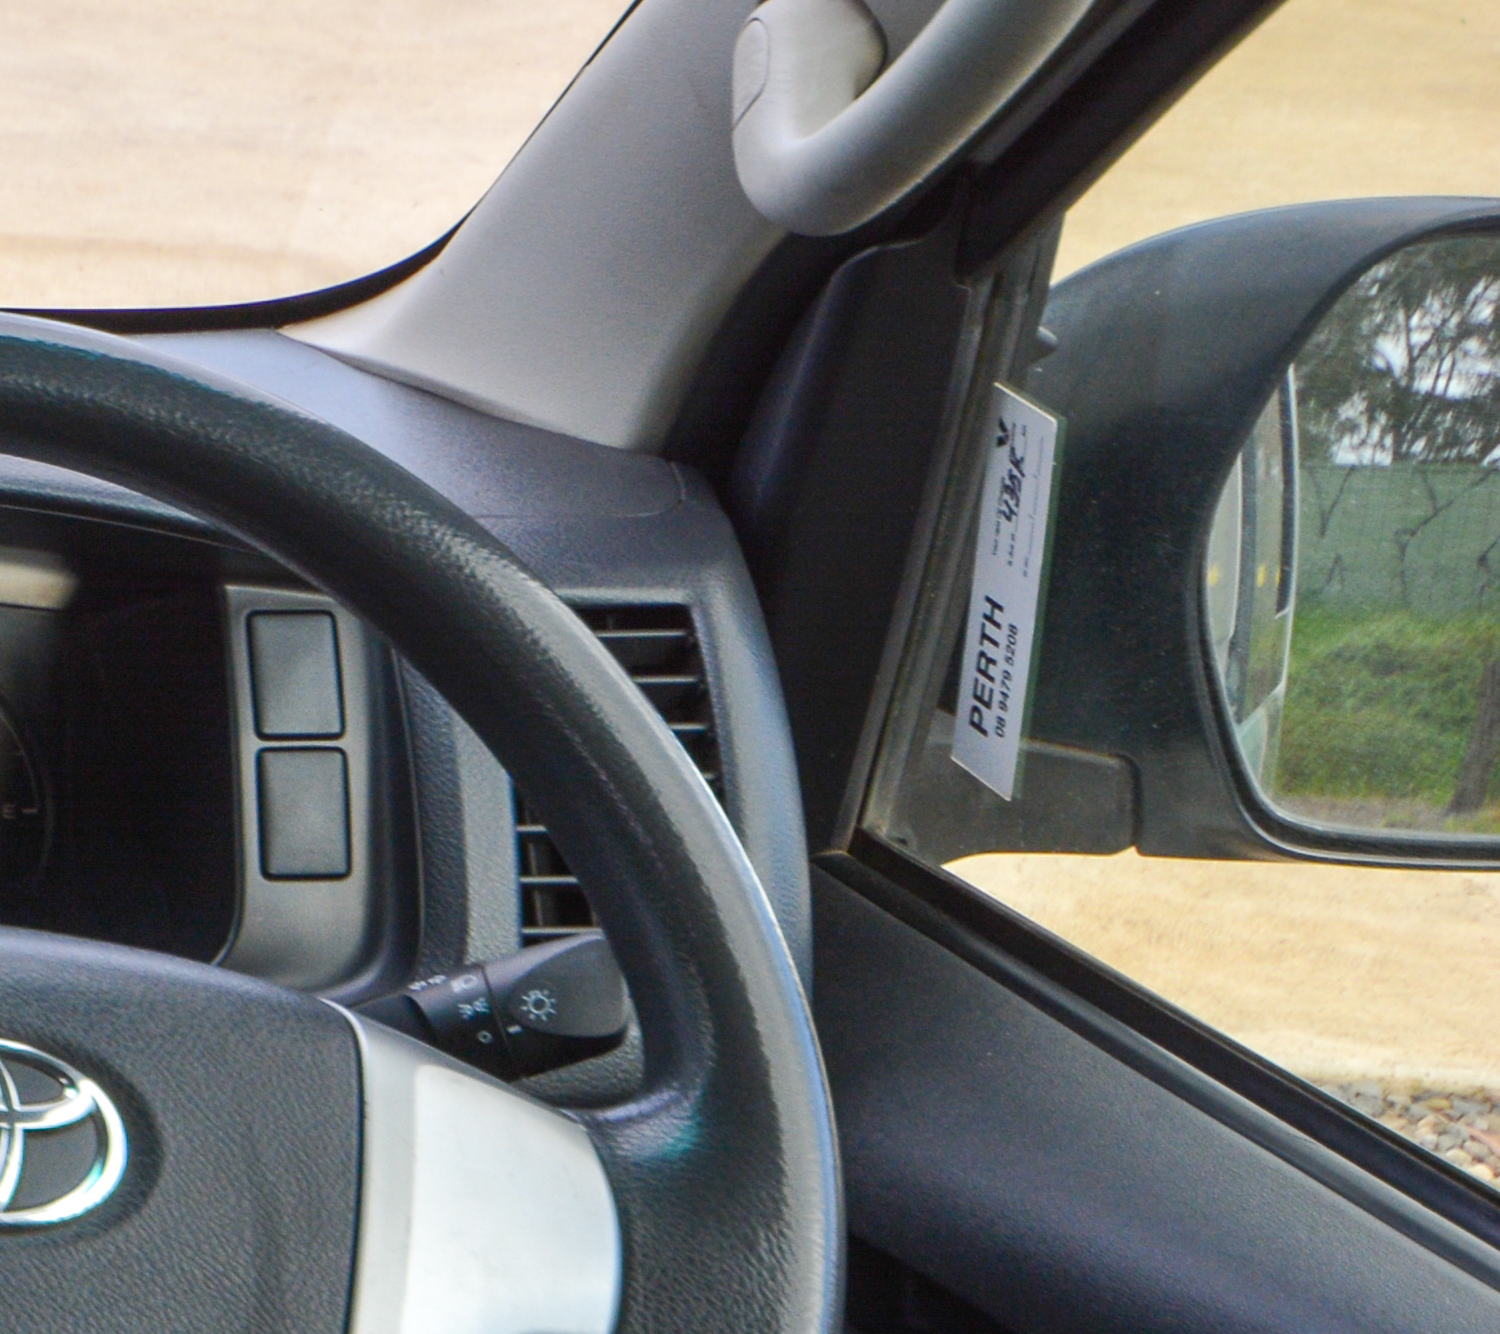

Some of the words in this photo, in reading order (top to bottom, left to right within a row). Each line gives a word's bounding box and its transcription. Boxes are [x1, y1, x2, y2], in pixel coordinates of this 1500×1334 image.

[969, 594, 1004, 738] PERTH
[1006, 623, 1019, 667] 5208
[998, 670, 1013, 715] 9479
[994, 715, 1006, 739] 08
